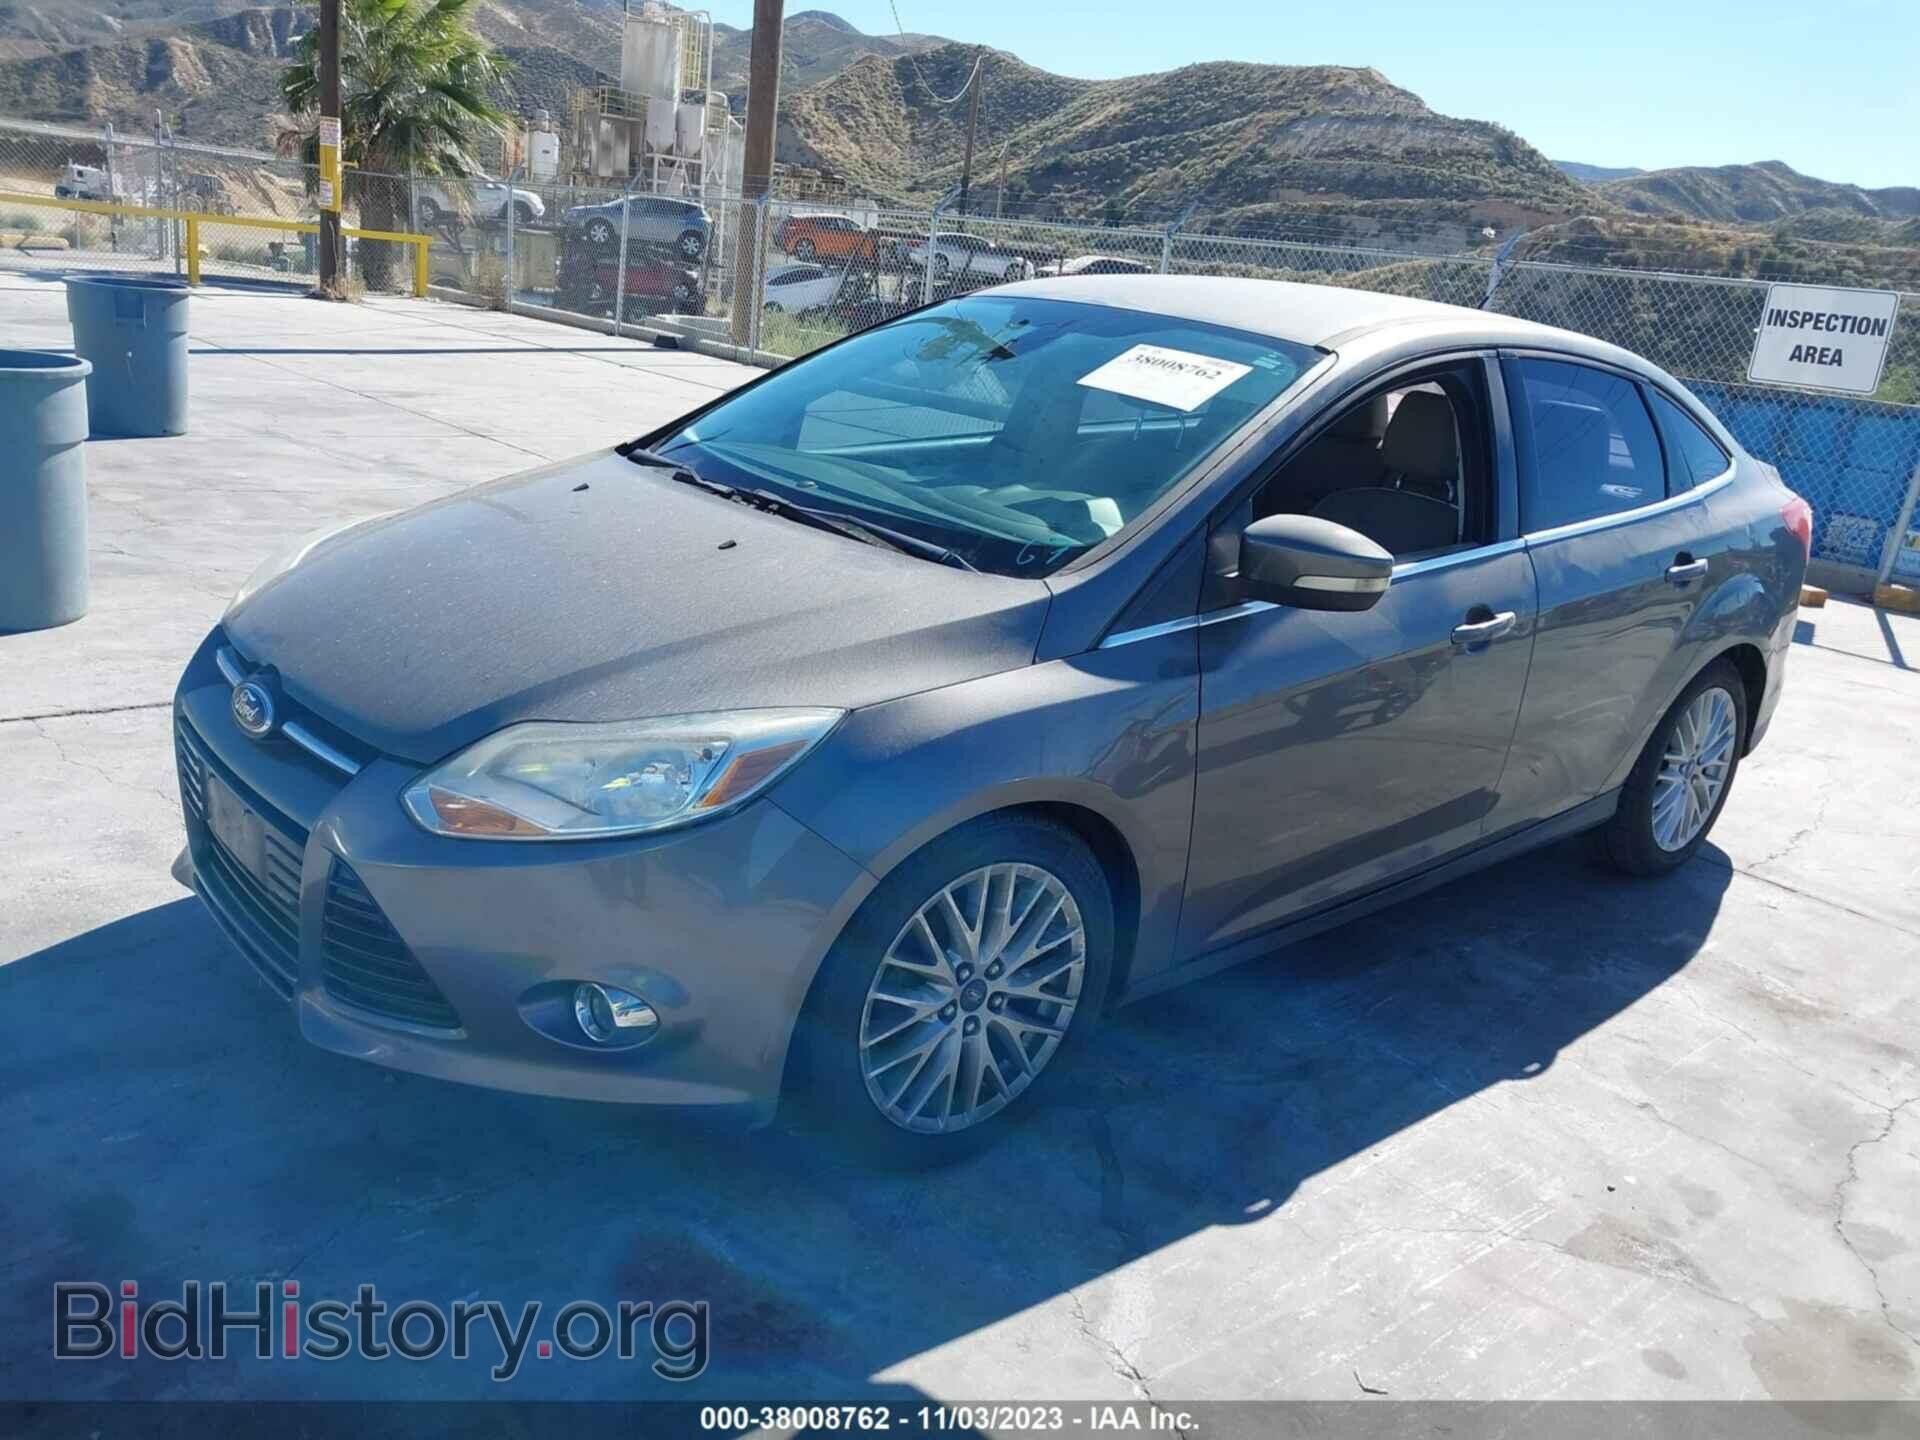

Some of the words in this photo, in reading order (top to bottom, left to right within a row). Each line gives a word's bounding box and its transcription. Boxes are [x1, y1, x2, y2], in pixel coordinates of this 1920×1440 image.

[1766, 308, 1887, 337] INSPECTION
[1135, 353, 1222, 380] 38008762
[1788, 344, 1843, 367] AREA
[235, 688, 260, 722] Ford
